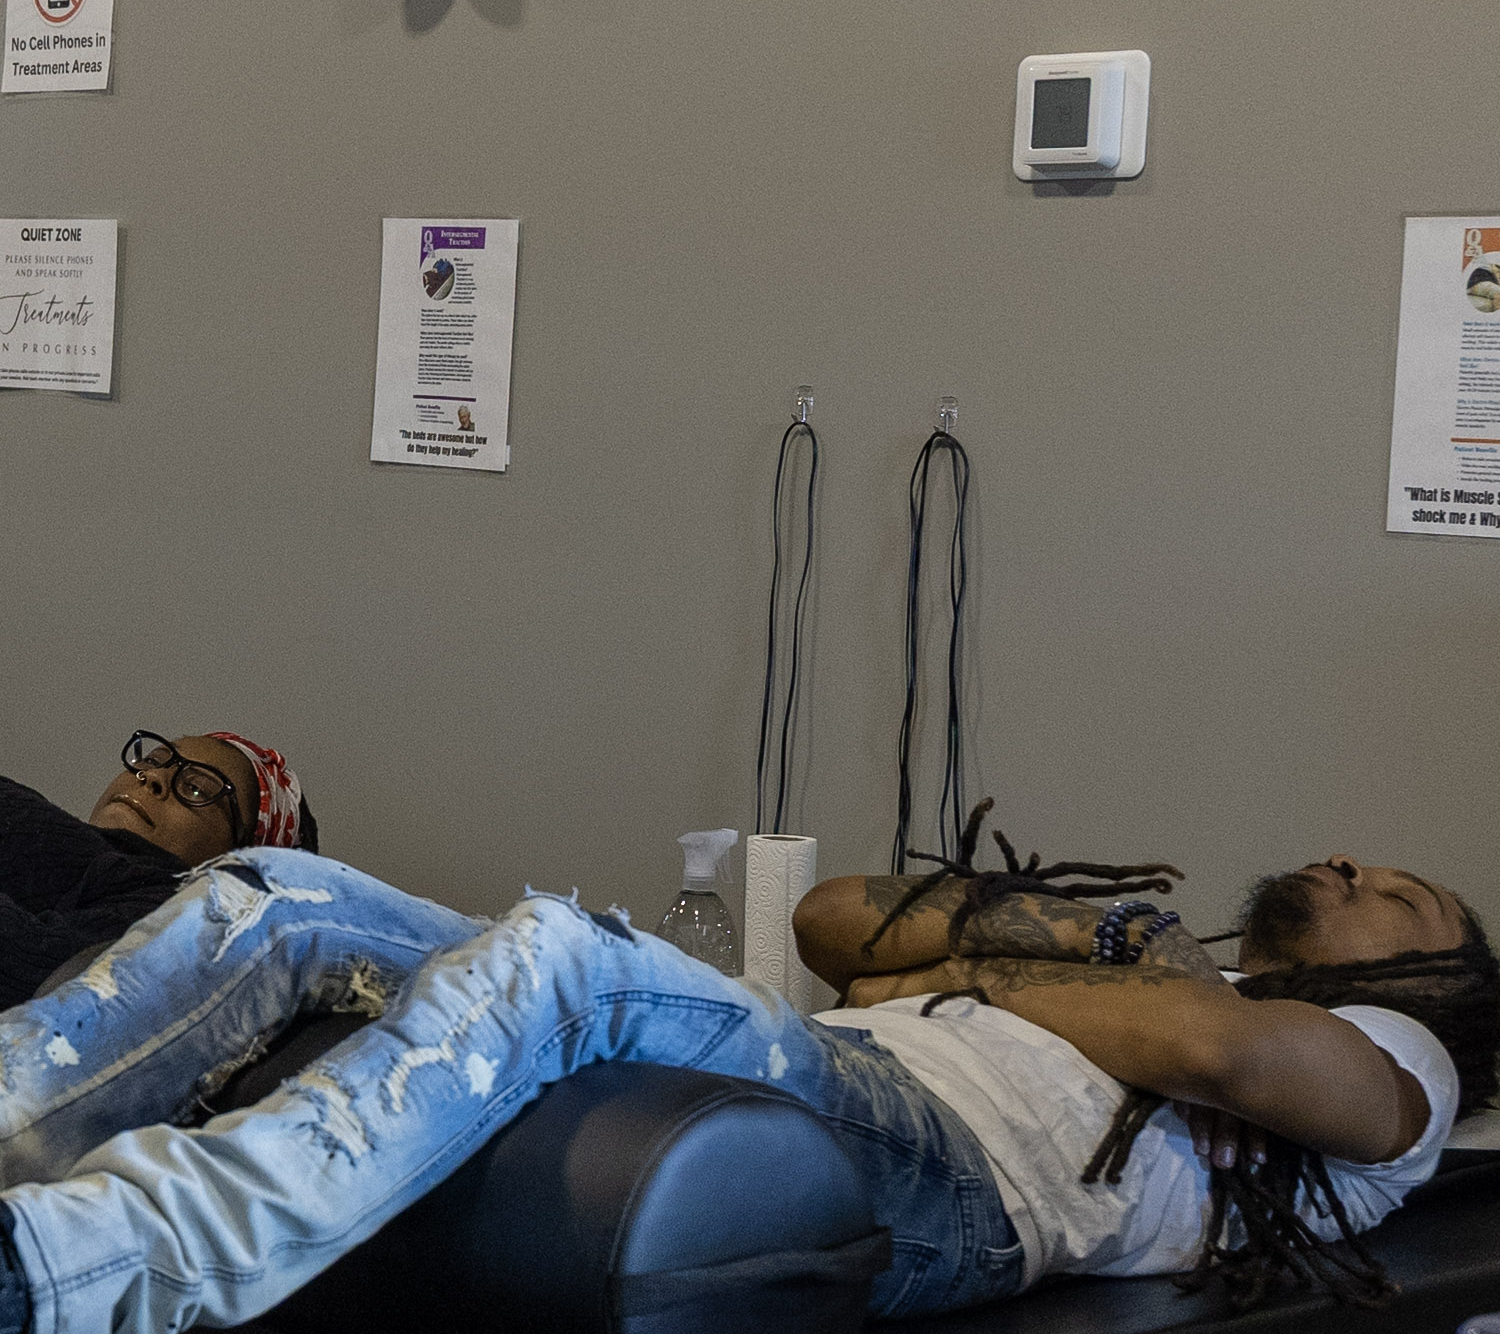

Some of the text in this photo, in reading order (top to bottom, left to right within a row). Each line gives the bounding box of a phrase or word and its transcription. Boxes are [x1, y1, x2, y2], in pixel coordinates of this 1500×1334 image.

[11, 32, 106, 51] No Cell Phones in
[12, 59, 102, 76] Treatment Areas
[21, 228, 82, 241] QUIET ZONE
[5, 255, 94, 265] PLEASE SILENCE PHONES
[15, 269, 83, 278] AND SPEAK SOFTLY
[22, 343, 97, 355] PROGRESS
[1404, 487, 1437, 502] "What
[1440, 489, 1450, 503] is
[1453, 489, 1494, 505] Muscle
[1412, 509, 1446, 524] shock
[1449, 512, 1466, 524] me
[1469, 512, 1476, 525] &
